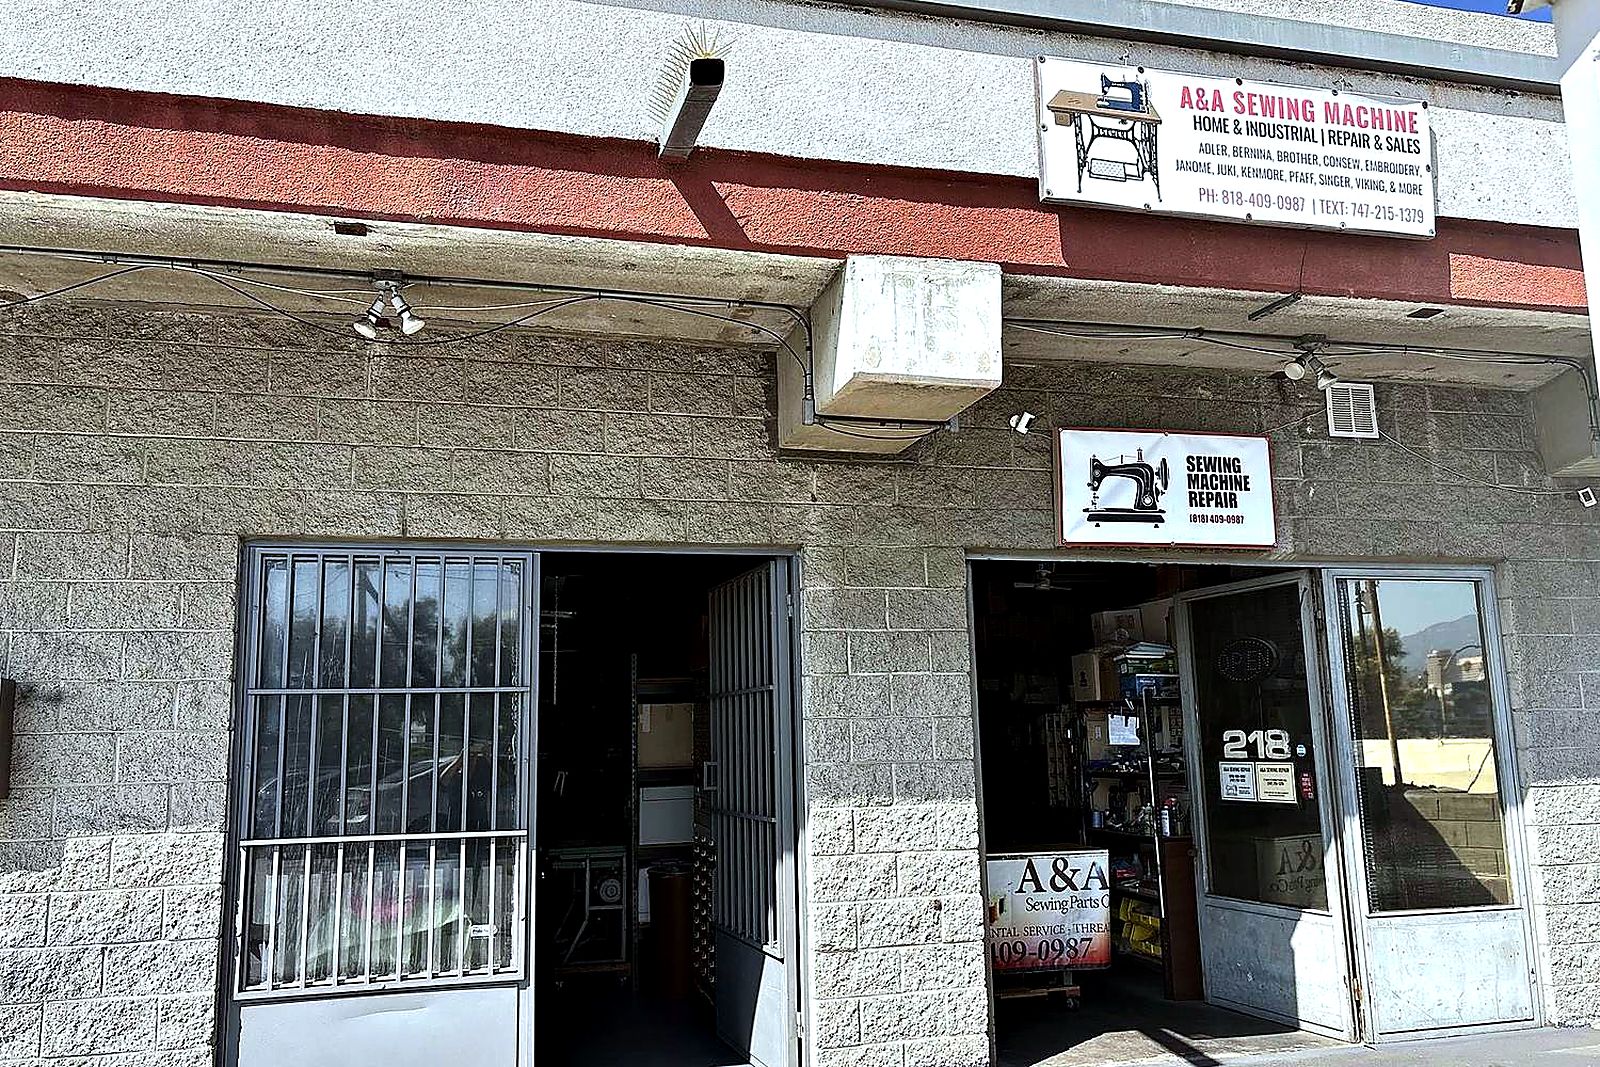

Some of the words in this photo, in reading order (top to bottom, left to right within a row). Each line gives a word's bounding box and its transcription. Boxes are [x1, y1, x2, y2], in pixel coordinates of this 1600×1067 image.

[1180, 86, 1224, 112] A&A
[1233, 91, 1315, 122] SEWING
[1324, 101, 1419, 134] MACHINE
[1193, 115, 1230, 134] HOME
[1233, 119, 1242, 135] &
[1246, 121, 1318, 144] INDUSTRIAL
[1328, 130, 1370, 149] REPAIR
[1374, 135, 1383, 150] &
[1386, 136, 1421, 154] SALES
[1199, 142, 1231, 157] ADLER,
[1232, 146, 1275, 162] BERNINA,
[1277, 150, 1321, 167] BROTHER,
[1323, 155, 1363, 171] CONSEW,
[1365, 160, 1423, 178] EMBROIDERY,
[1176, 159, 1215, 175] JANOME,
[1217, 163, 1239, 178] JUKI,
[1241, 166, 1287, 182] KENMORE,
[1289, 171, 1317, 186] PFAFF,
[1319, 174, 1354, 189] SINGER,
[1355, 178, 1388, 193] VIKING,
[1389, 181, 1396, 193] &
[1399, 183, 1423, 195] MORE
[1199, 188, 1219, 203] PH:
[1222, 190, 1305, 211] 818-409-0987
[1319, 199, 1348, 215] TEXT:
[1351, 203, 1424, 223] 747-215-1379
[1186, 455, 1241, 474] SEWING
[1187, 473, 1250, 491] MACHINE
[1188, 491, 1238, 508] REPAIR
[1210, 515, 1244, 524] 409-0987
[1223, 729, 1291, 759] 218
[1015, 857, 1109, 893] A&A
[1026, 896, 1069, 915] Sewing
[1070, 895, 1099, 909] Parts
[1023, 924, 1065, 937] SERVICE
